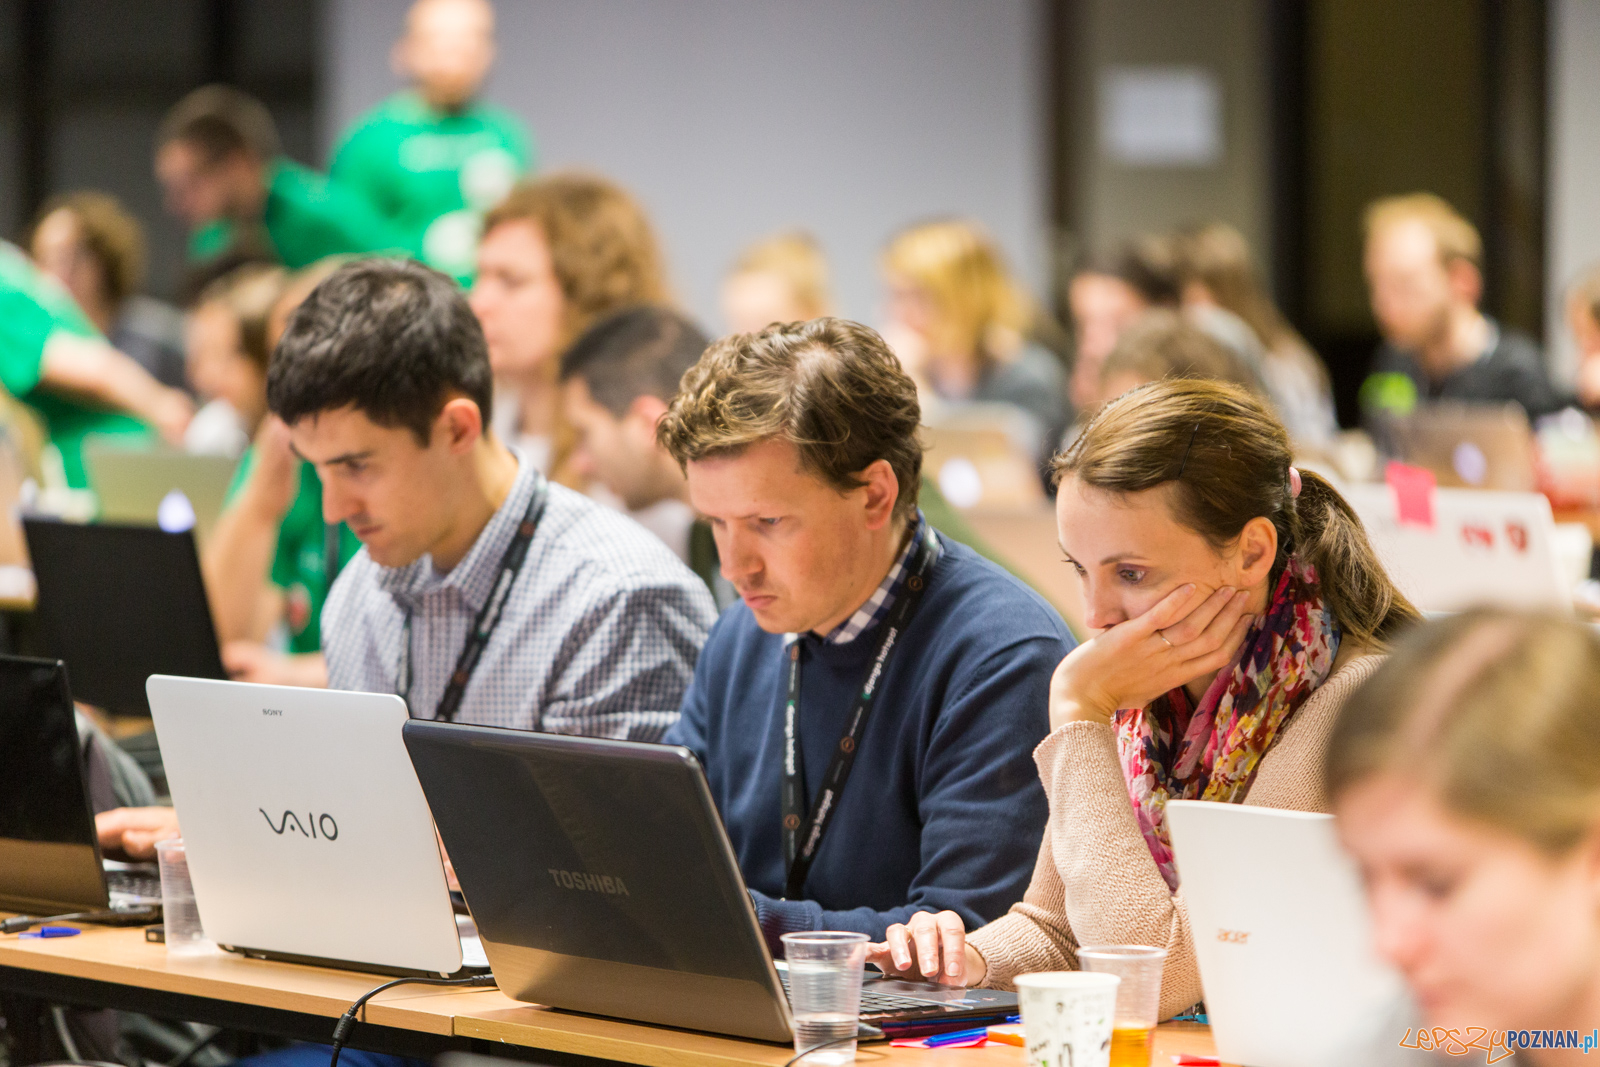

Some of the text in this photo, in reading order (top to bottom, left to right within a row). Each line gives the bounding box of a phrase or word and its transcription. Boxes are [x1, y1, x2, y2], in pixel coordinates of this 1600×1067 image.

[863, 626, 899, 694] django hotspot
[262, 708, 283, 716] SONY
[259, 807, 339, 841] VAIO
[547, 868, 630, 896] TOSHIBA
[1216, 928, 1252, 945] acer
